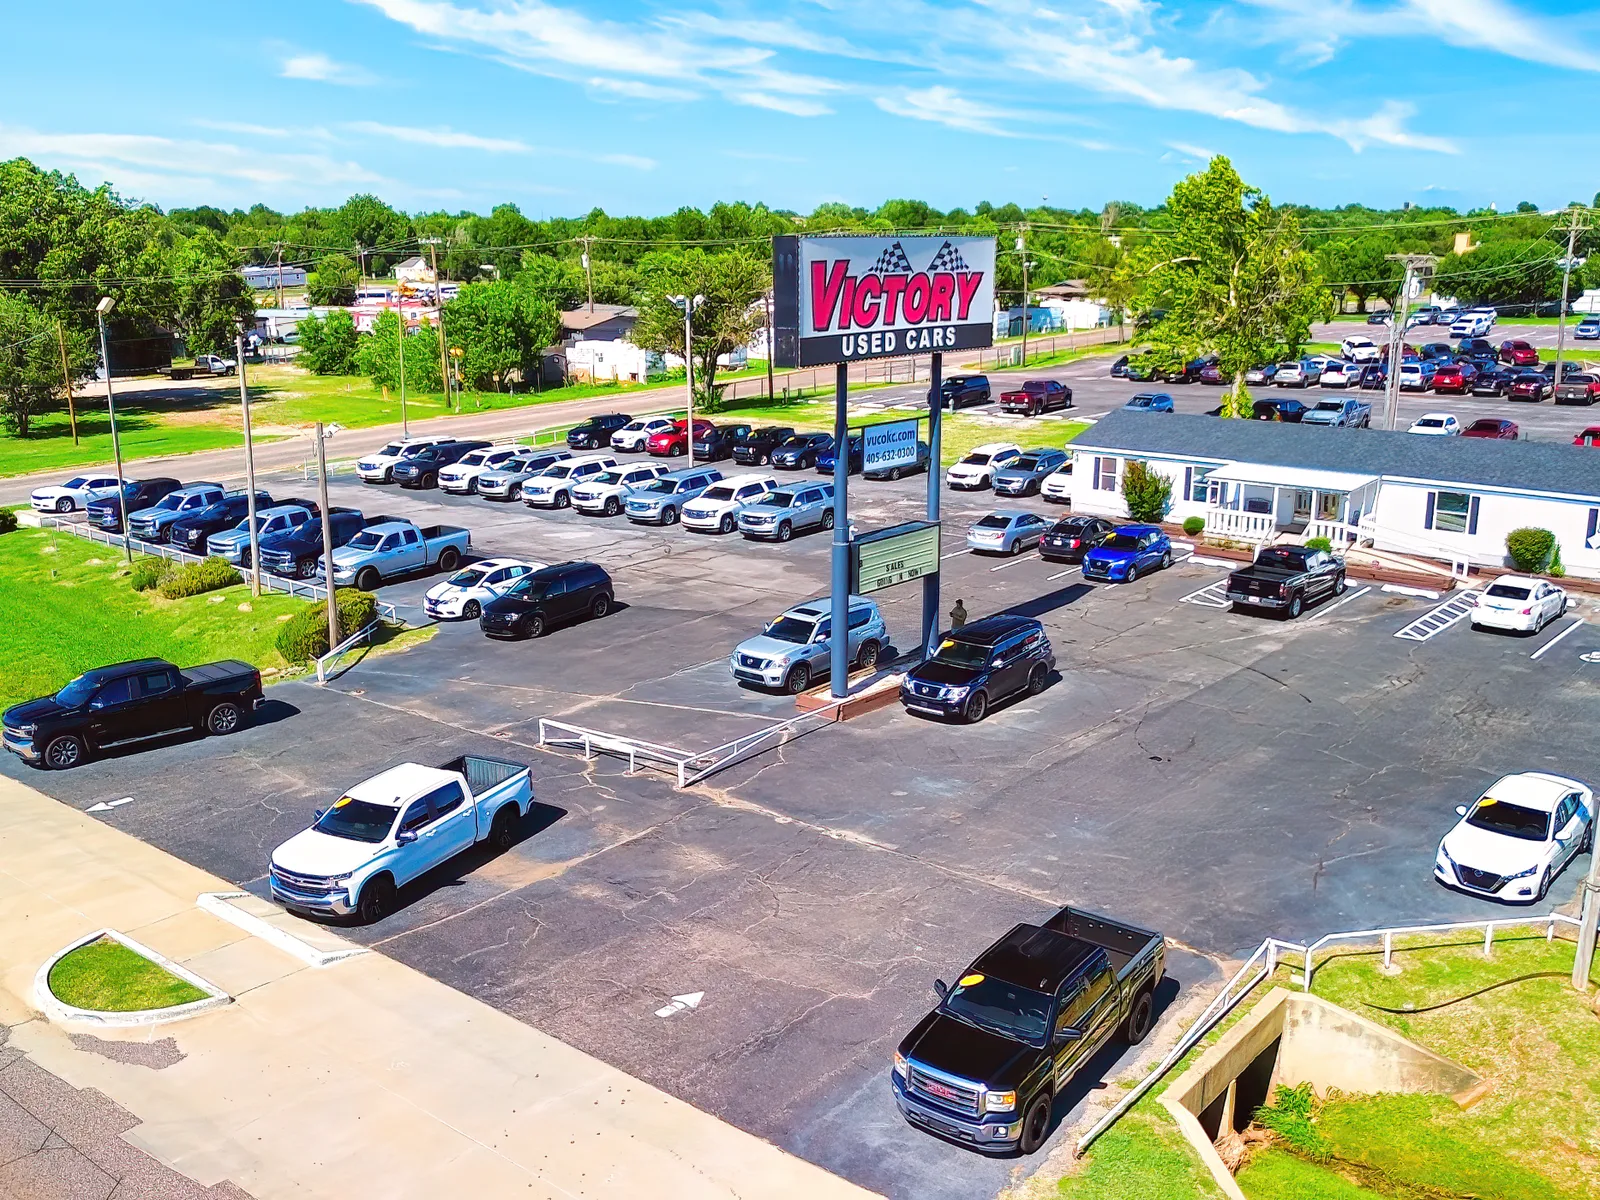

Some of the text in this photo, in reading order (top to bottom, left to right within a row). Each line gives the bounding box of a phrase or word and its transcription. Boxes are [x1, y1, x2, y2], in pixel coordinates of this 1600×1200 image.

[811, 259, 984, 332] VICTORY
[842, 326, 957, 357] USED CARS
[866, 430, 915, 447] vucokc.com
[865, 446, 915, 464] 405-632-0300
[885, 560, 904, 572] SALES
